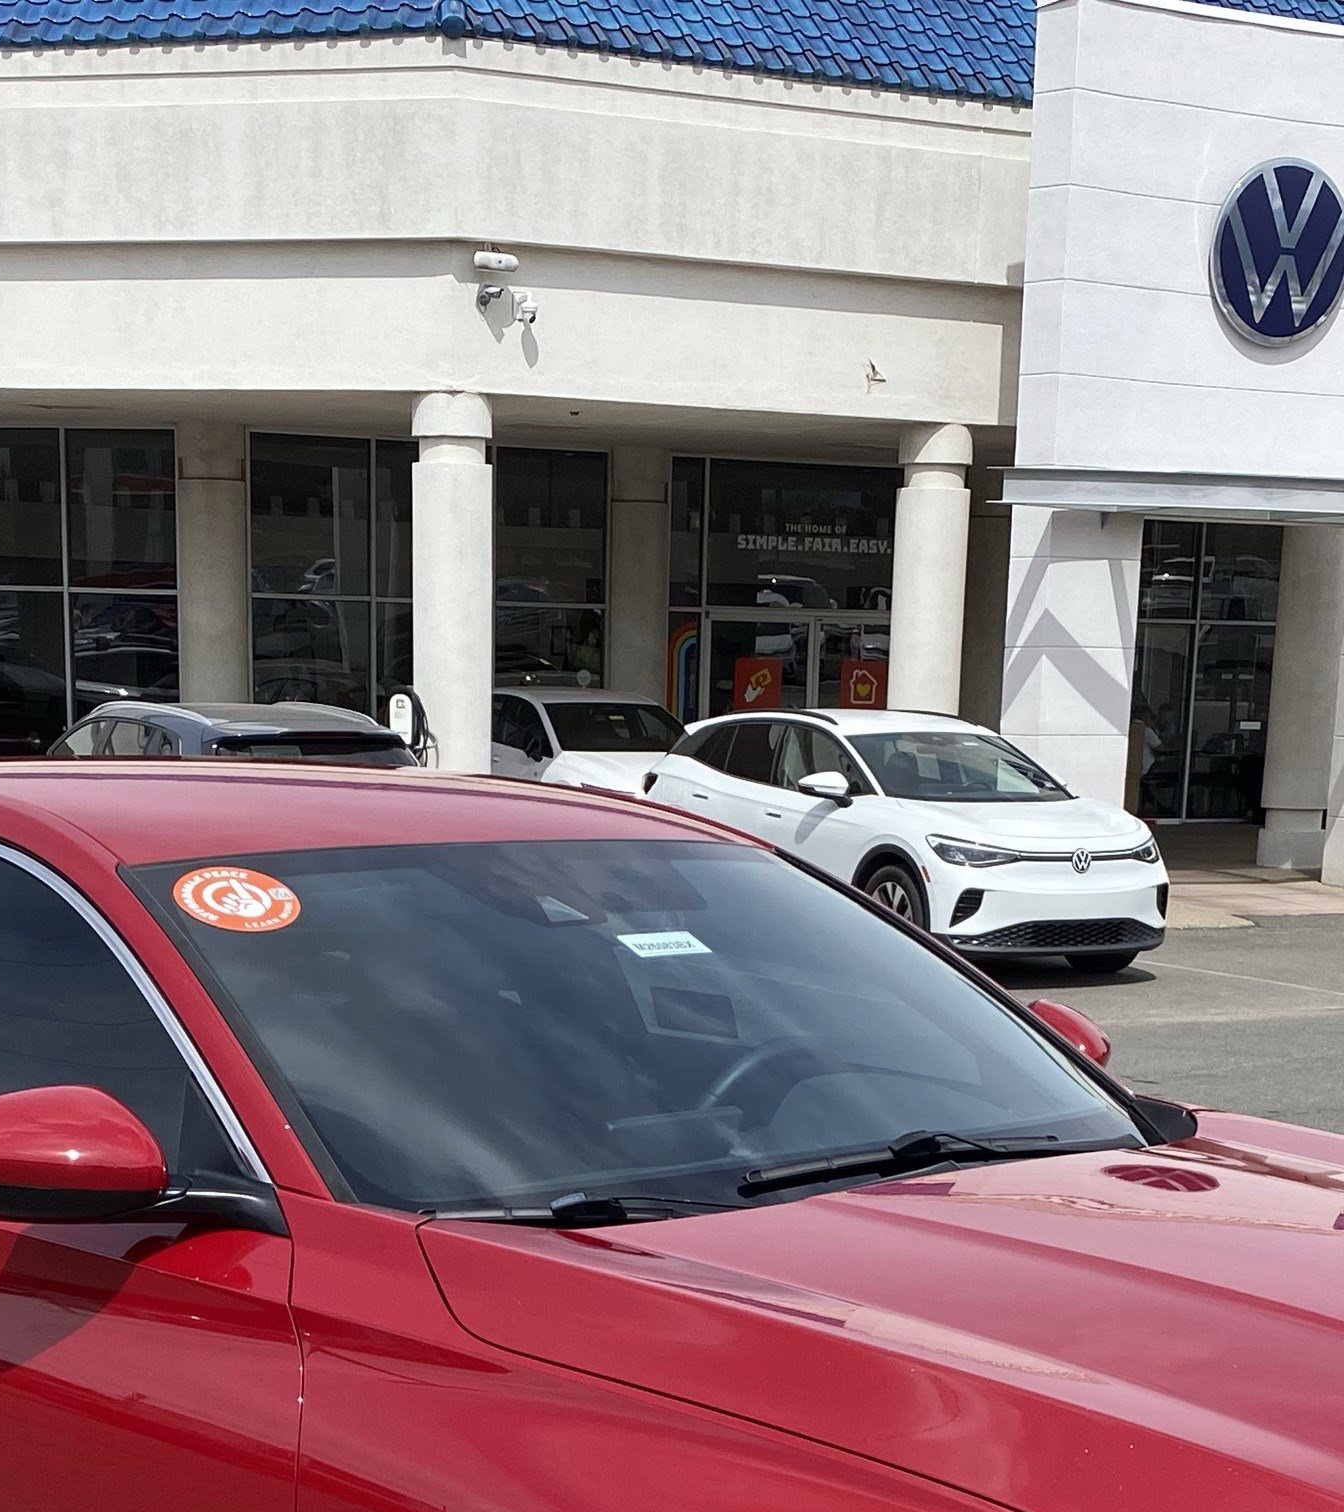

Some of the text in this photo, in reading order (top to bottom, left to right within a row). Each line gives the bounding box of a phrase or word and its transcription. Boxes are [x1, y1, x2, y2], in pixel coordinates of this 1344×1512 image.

[785, 523, 847, 534] THE HOME OF
